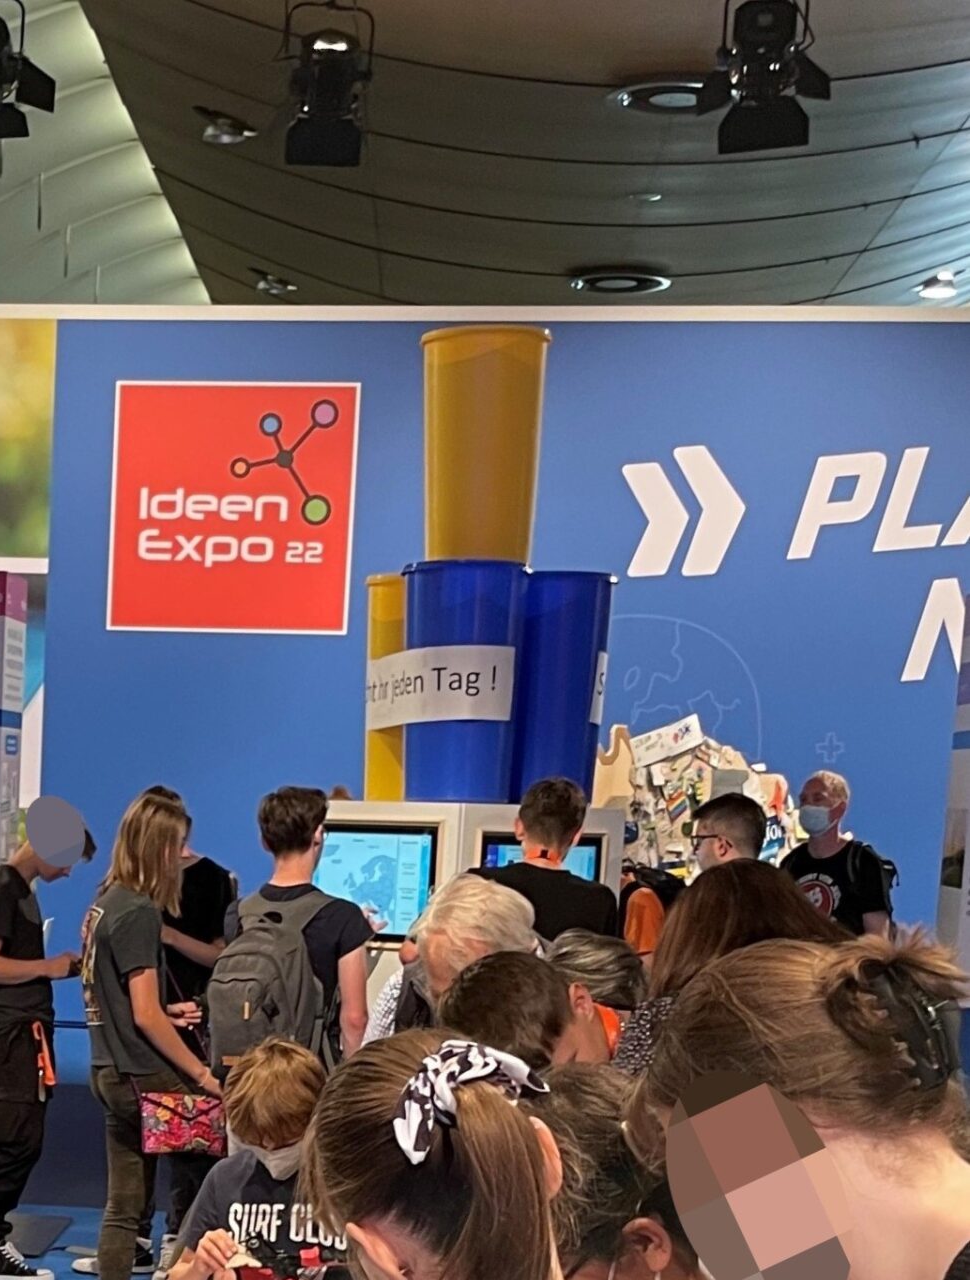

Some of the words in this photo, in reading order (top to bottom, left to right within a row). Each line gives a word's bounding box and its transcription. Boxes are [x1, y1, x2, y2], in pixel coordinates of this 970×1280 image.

[139, 487, 288, 522] Ideen
[137, 528, 274, 568] Expo
[285, 541, 324, 564] 22
[390, 669, 424, 704] jeden
[431, 666, 481, 696] Tag
[228, 1202, 285, 1250] SURF
